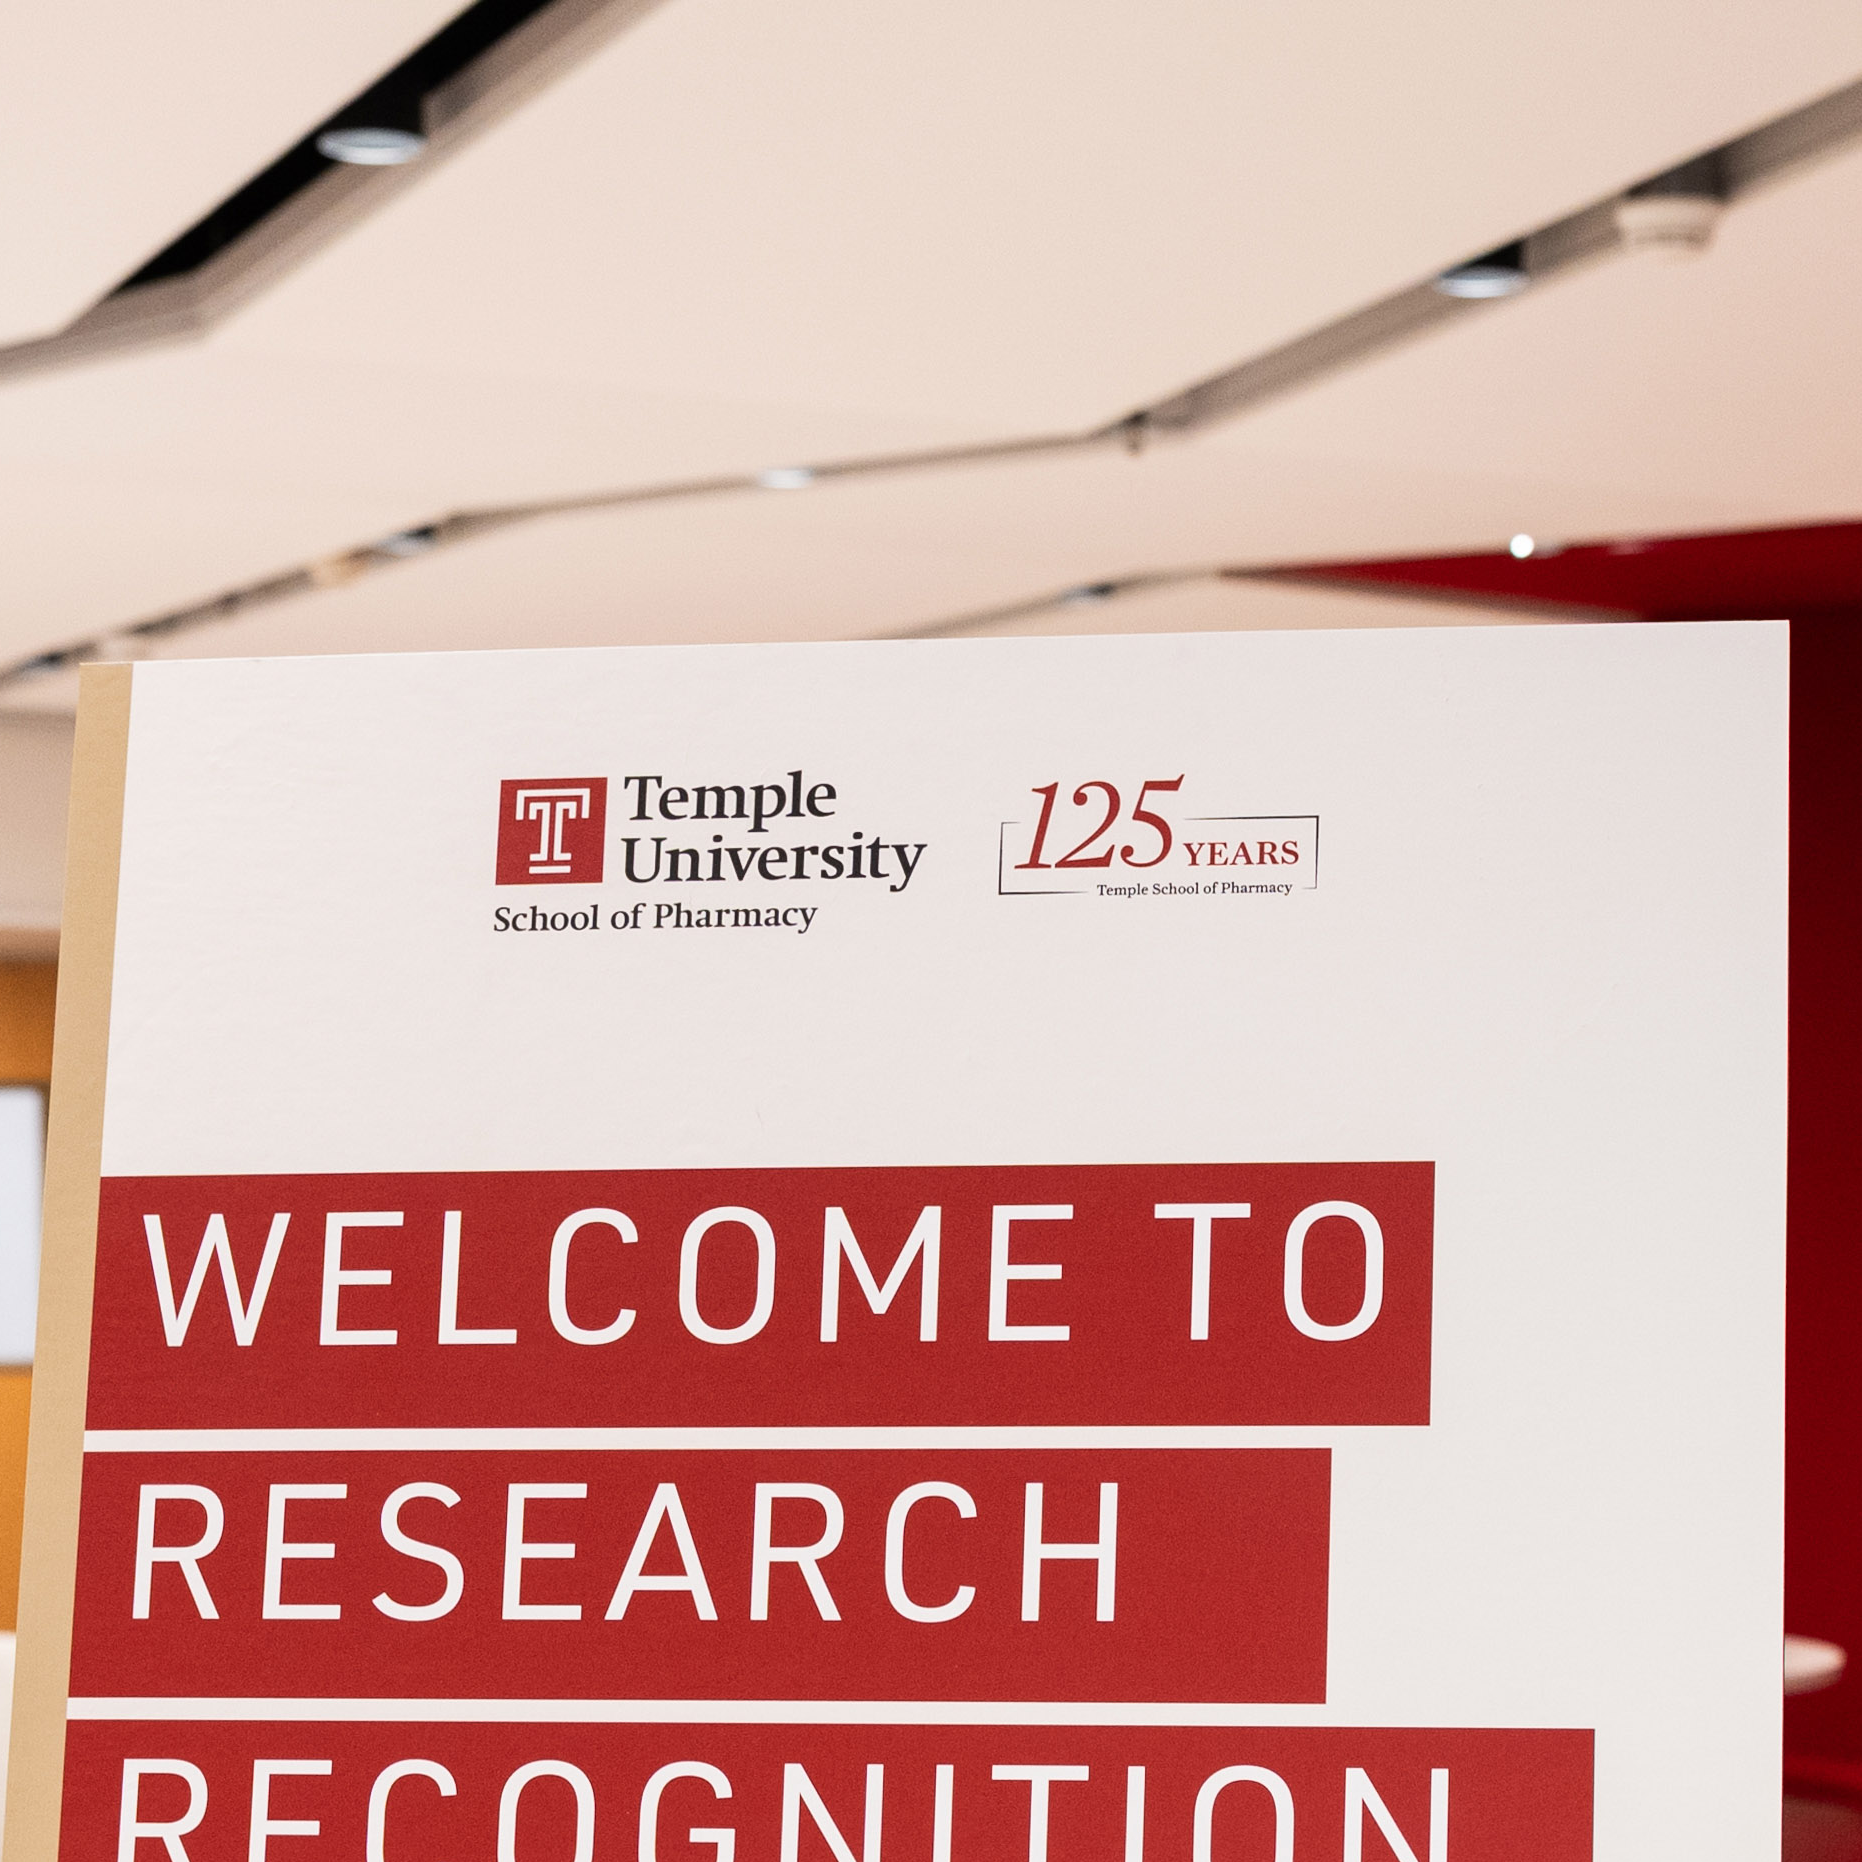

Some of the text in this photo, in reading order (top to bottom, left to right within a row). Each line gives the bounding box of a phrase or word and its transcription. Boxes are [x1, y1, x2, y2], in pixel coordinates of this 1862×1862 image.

[623, 769, 839, 829] Temple
[1013, 773, 1301, 872] 125 YEARS
[620, 829, 929, 895] University
[1096, 881, 1293, 898] Temple School of Pharmacy
[493, 902, 821, 937] School of Pharmacy
[141, 1200, 1387, 1349] WELCOME TO
[131, 1480, 1121, 1625] RESEARCH
